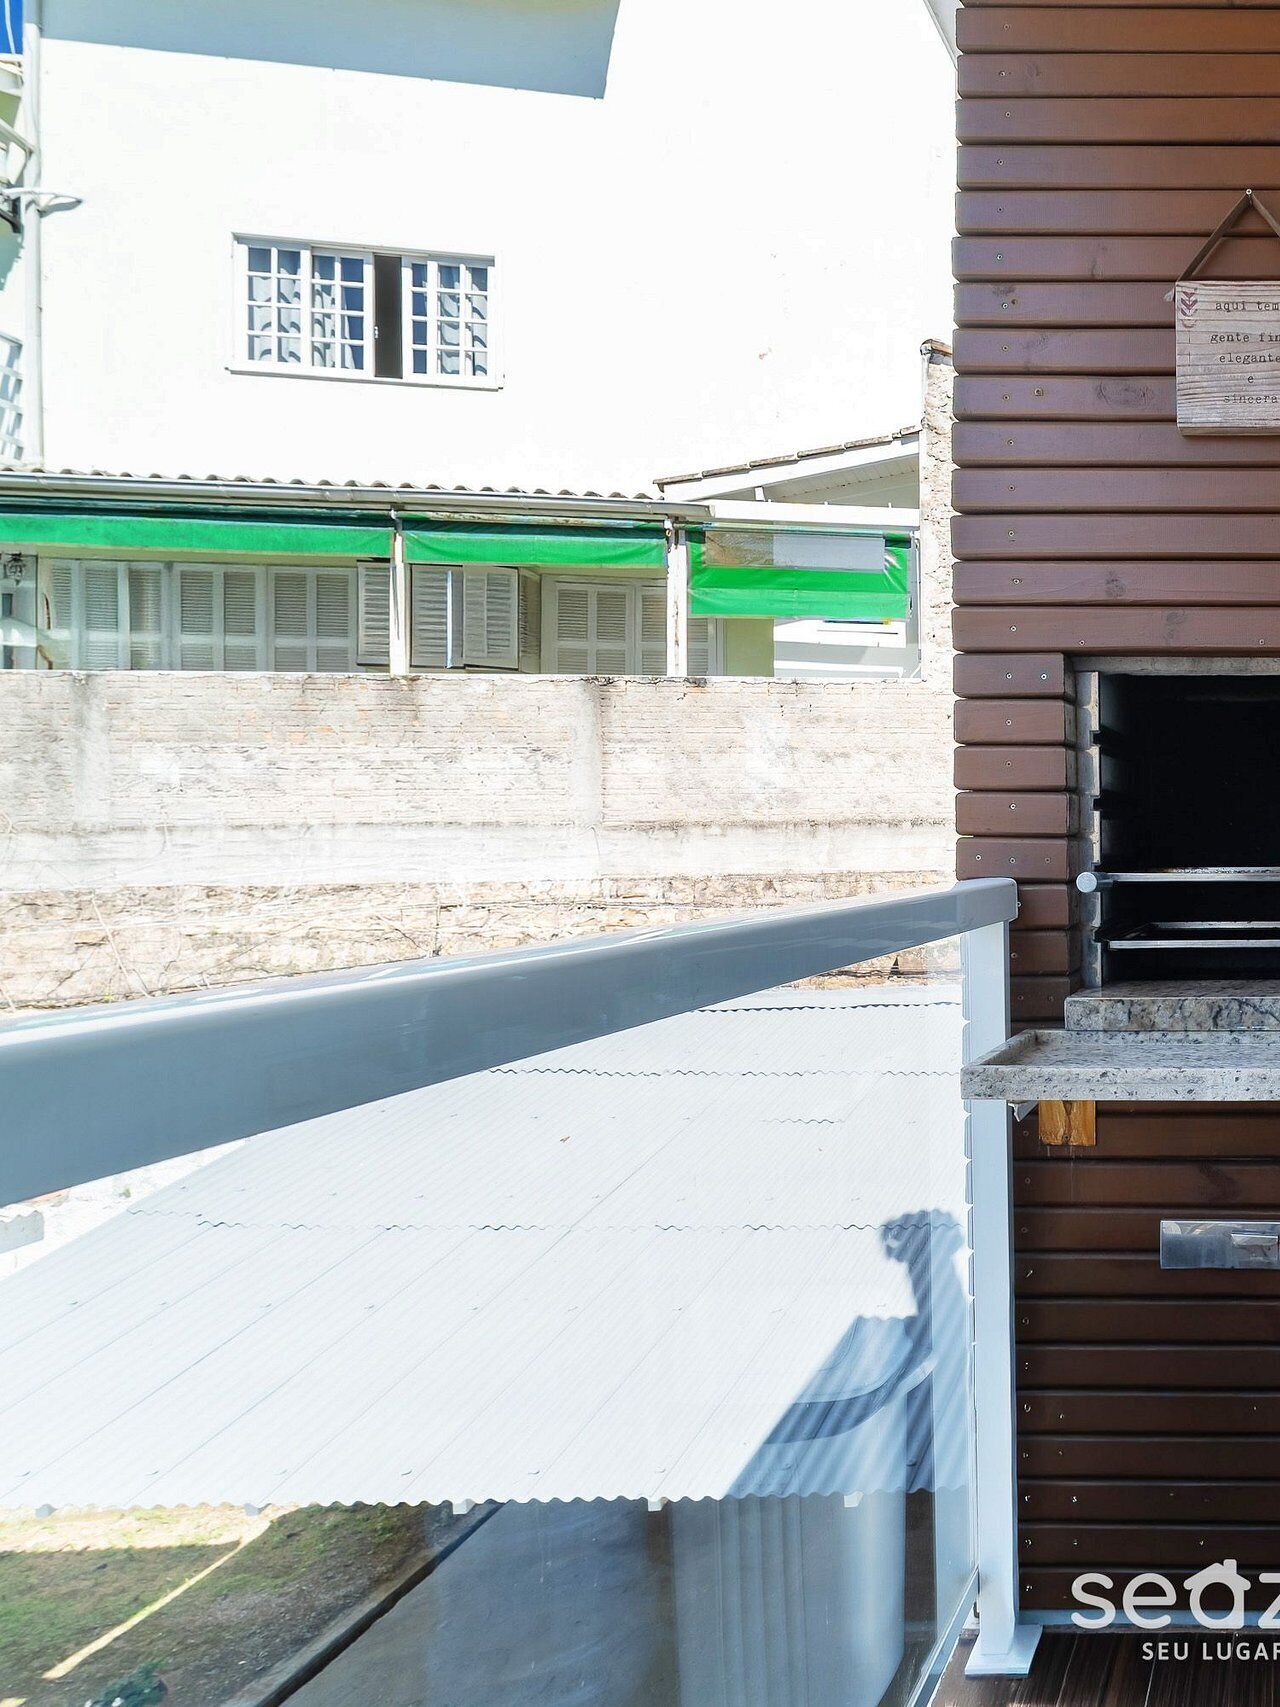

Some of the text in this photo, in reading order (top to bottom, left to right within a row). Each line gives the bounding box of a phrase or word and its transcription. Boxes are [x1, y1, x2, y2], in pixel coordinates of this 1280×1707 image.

[1215, 301, 1246, 313] aqui
[1210, 333, 1250, 344] gente
[1247, 376, 1254, 384] e
[1223, 393, 1279, 404] sincera
